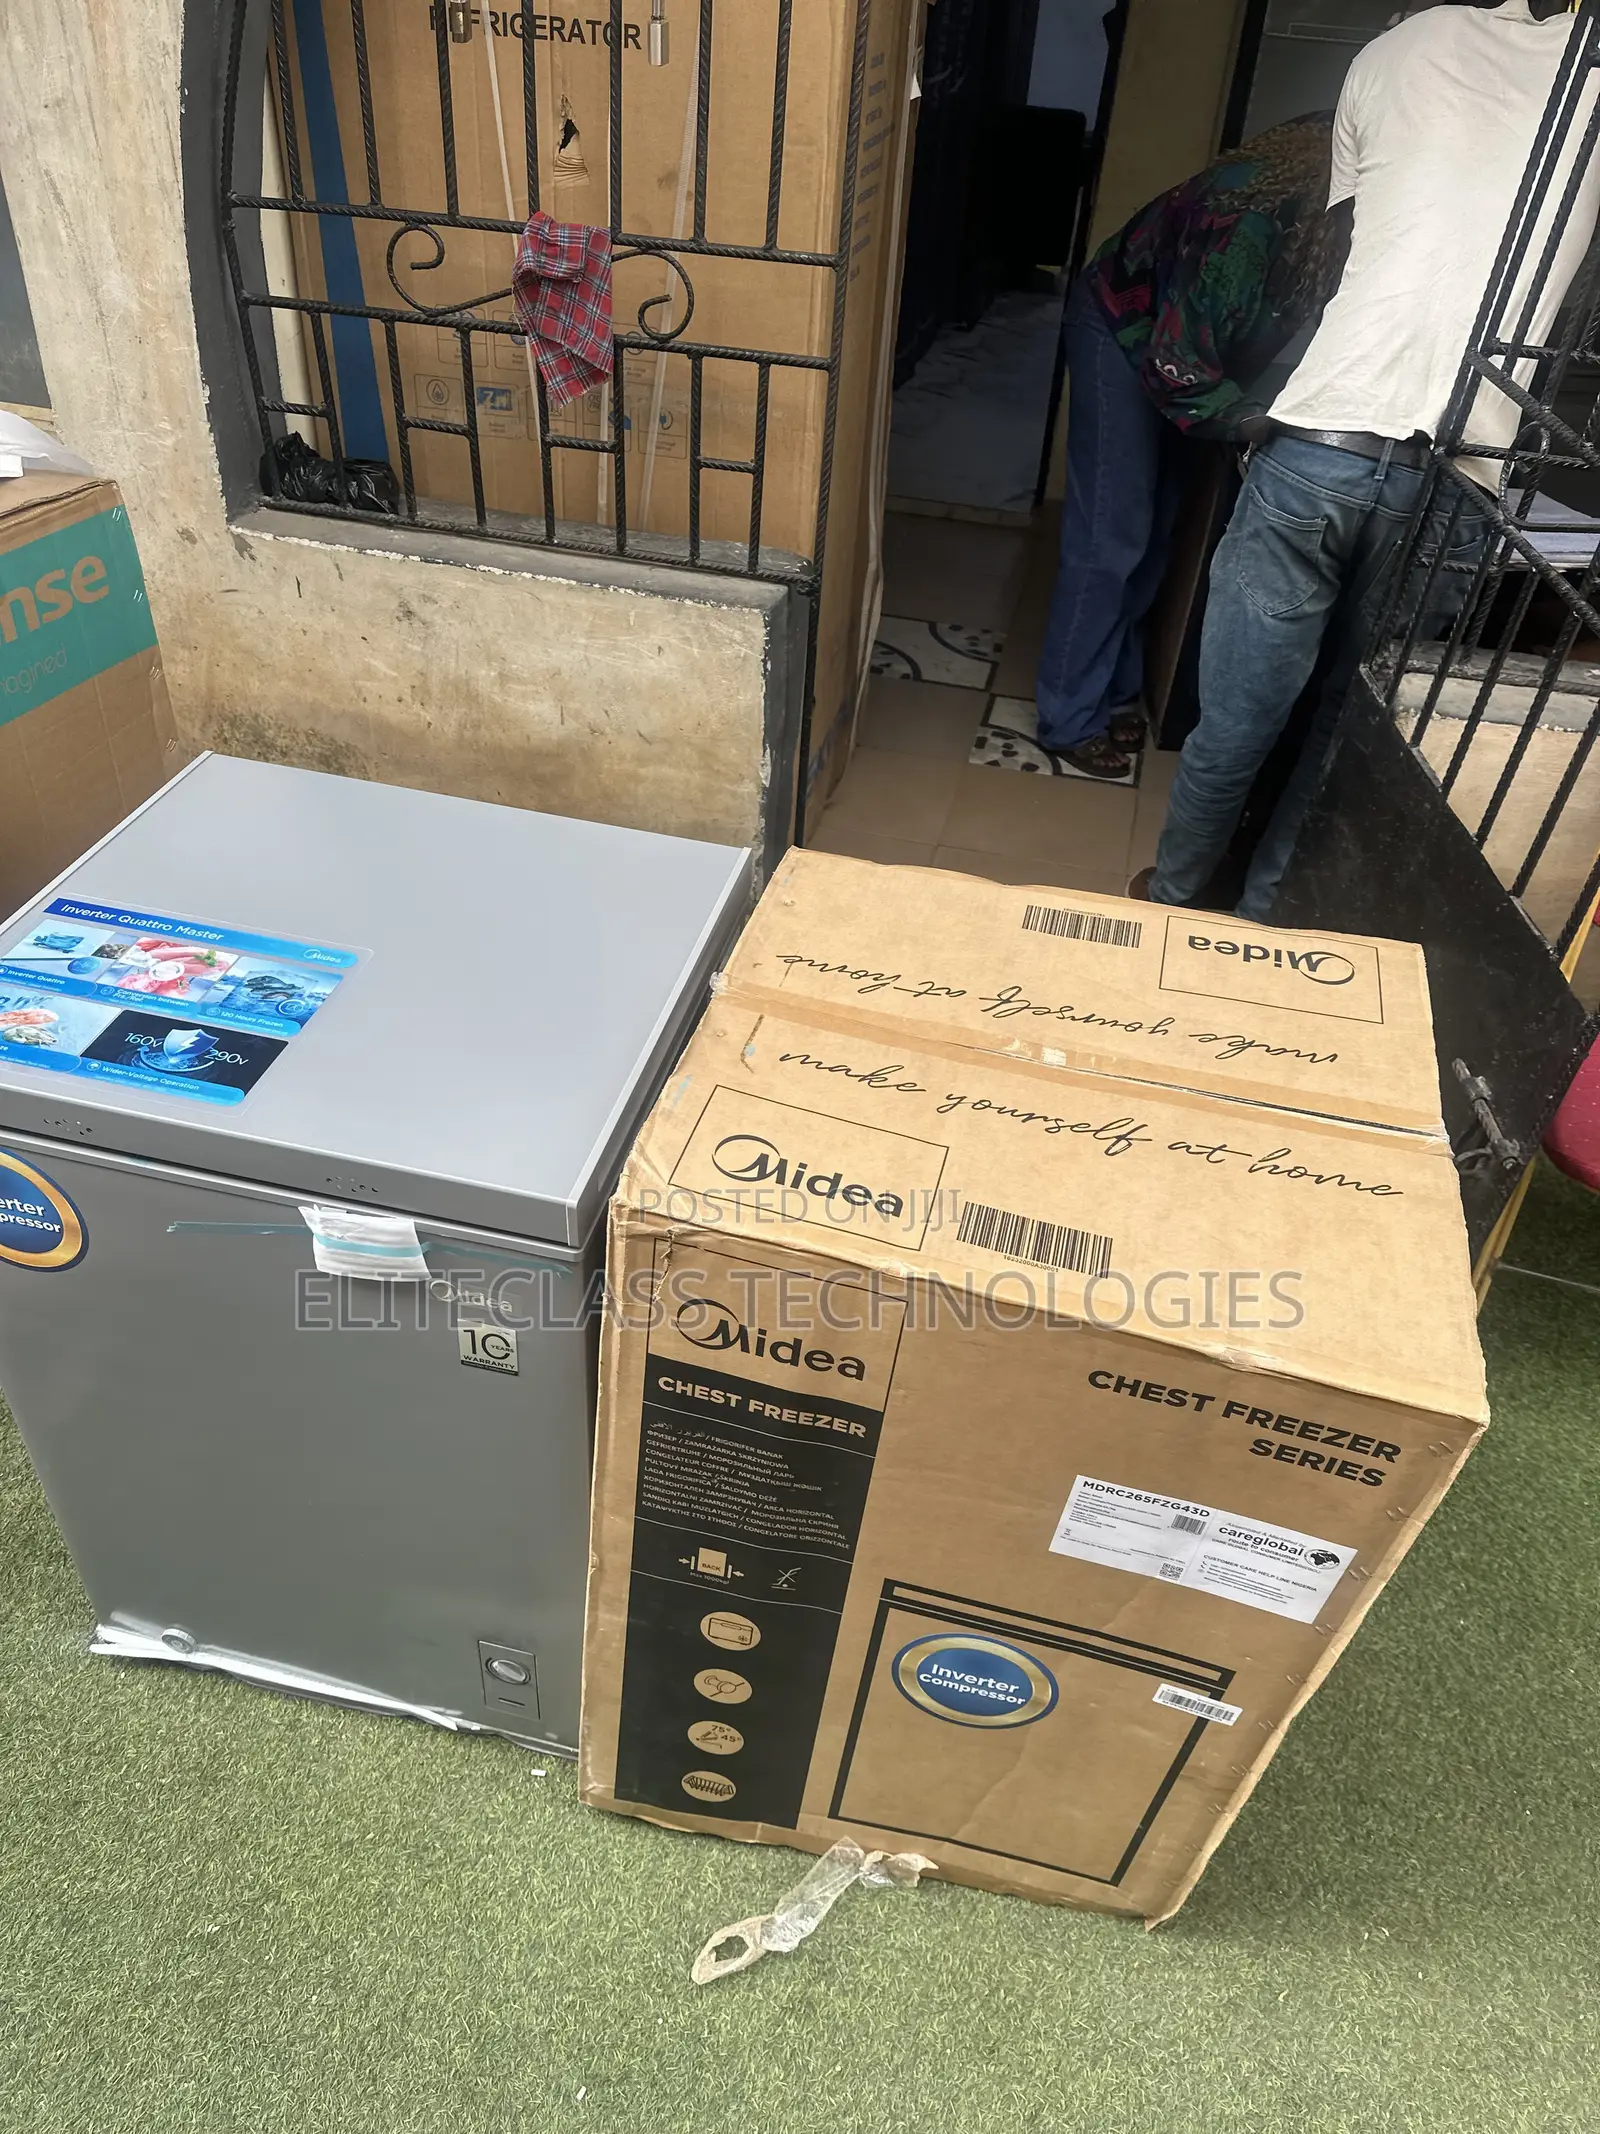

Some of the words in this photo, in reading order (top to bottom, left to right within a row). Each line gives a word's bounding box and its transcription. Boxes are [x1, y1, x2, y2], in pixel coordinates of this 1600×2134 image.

[60, 904, 117, 921] Inverter
[118, 915, 173, 931] Quattro
[175, 925, 225, 941] Master
[303, 949, 342, 964] Midea
[1187, 935, 1356, 985] Midea
[7, 970, 37, 979] Inverter
[37, 975, 66, 985] Quattro
[979, 985, 1176, 1036] yourself
[124, 1032, 163, 1048] 160v
[204, 1048, 249, 1065] 290v
[101, 1066, 159, 1083] Wider-Voltage
[159, 1078, 200, 1091] Operation
[779, 1053, 926, 1092] make
[936, 1092, 1153, 1157] yourself
[1168, 1141, 1253, 1164] at
[1247, 1147, 1404, 1196] home
[711, 1134, 904, 1218] Midea
[490, 1344, 515, 1353] YEARS
[675, 1298, 866, 1381] Midea
[463, 1355, 515, 1370] WARRANTY
[658, 1376, 742, 1408] CHEST
[748, 1399, 867, 1438] FREEZER
[1087, 1370, 1216, 1412] CHEST
[1221, 1400, 1402, 1463] FREEZER
[711, 1436, 755, 1453] FRIGORIFER
[738, 1453, 789, 1469] SKRZYNIOWA
[1248, 1438, 1388, 1488] SERIES
[643, 1483, 698, 1501] HORIZONTALNI
[1082, 1480, 1210, 1518] MDRC265FZG43D
[691, 1503, 739, 1519] MUZLATGICH
[745, 1517, 798, 1531] CONGELADOR
[799, 1526, 847, 1540] HORIZONTAL
[763, 1504, 784, 1513] ARCA
[786, 1508, 835, 1520] HORIZONTAL
[743, 1525, 798, 1539] CONGELATORE
[799, 1535, 850, 1549] ORIZZONTALE
[1219, 1527, 1304, 1556] careglobal
[1228, 1538, 1249, 1547] route
[1260, 1546, 1299, 1562] consumer
[701, 1563, 721, 1572] BACK
[1203, 1554, 1239, 1568] CUSTOMER
[1239, 1564, 1258, 1574] CARE
[1258, 1570, 1276, 1579] HELP
[1276, 1576, 1291, 1584] LINE
[1291, 1581, 1317, 1592] NIGERIA
[919, 1673, 1026, 1705] Compressor
[931, 1663, 1020, 1694] Inverter
